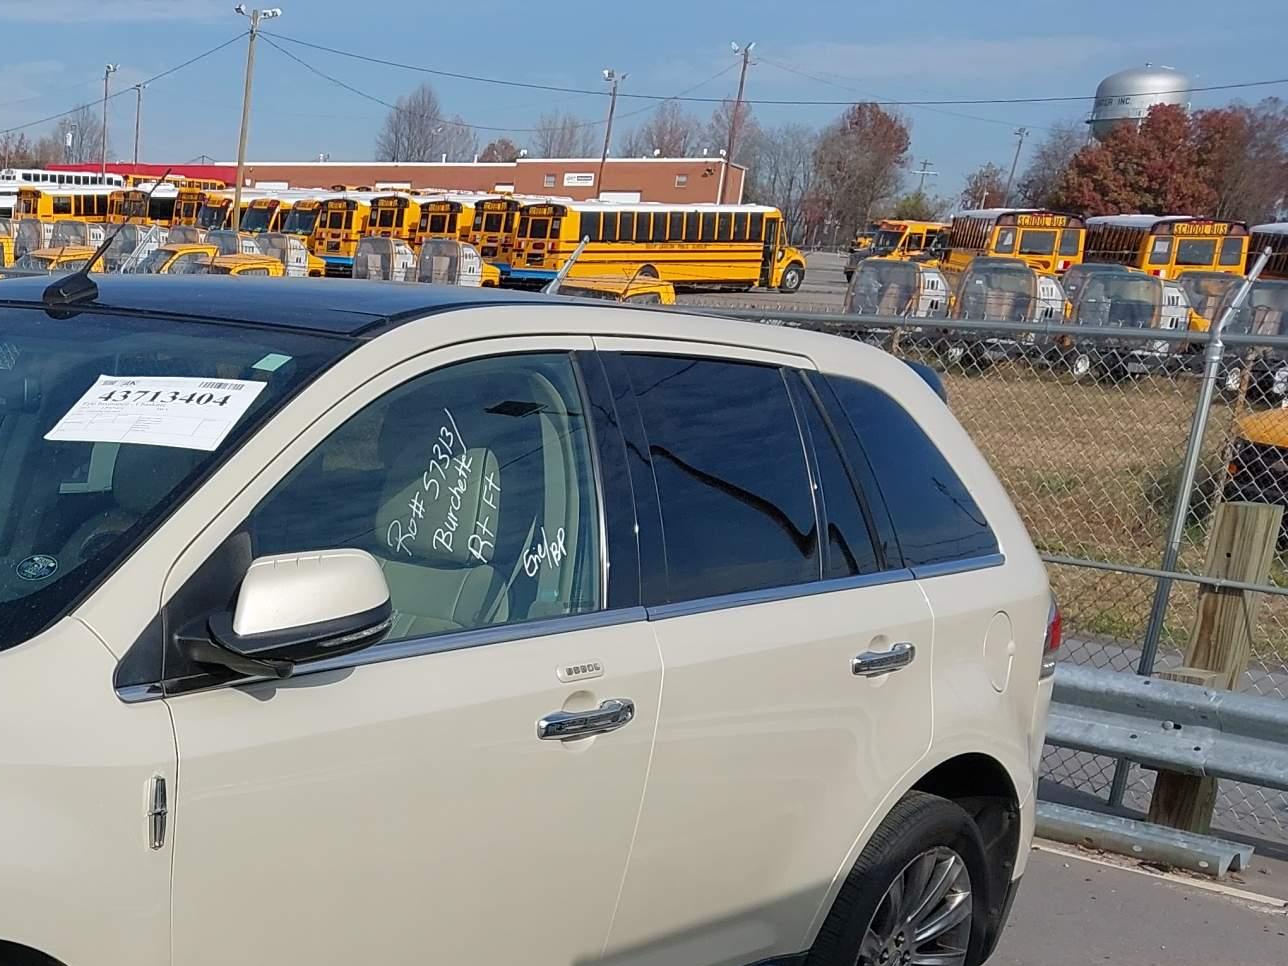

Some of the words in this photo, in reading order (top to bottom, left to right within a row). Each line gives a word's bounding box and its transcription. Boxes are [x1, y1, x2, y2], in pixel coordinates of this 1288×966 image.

[1019, 215, 1046, 227] SCHOOL
[1050, 216, 1065, 227] BUS
[1176, 224, 1204, 234] SCHOOL
[1209, 224, 1226, 234] BUS
[98, 389, 232, 406] 43713404
